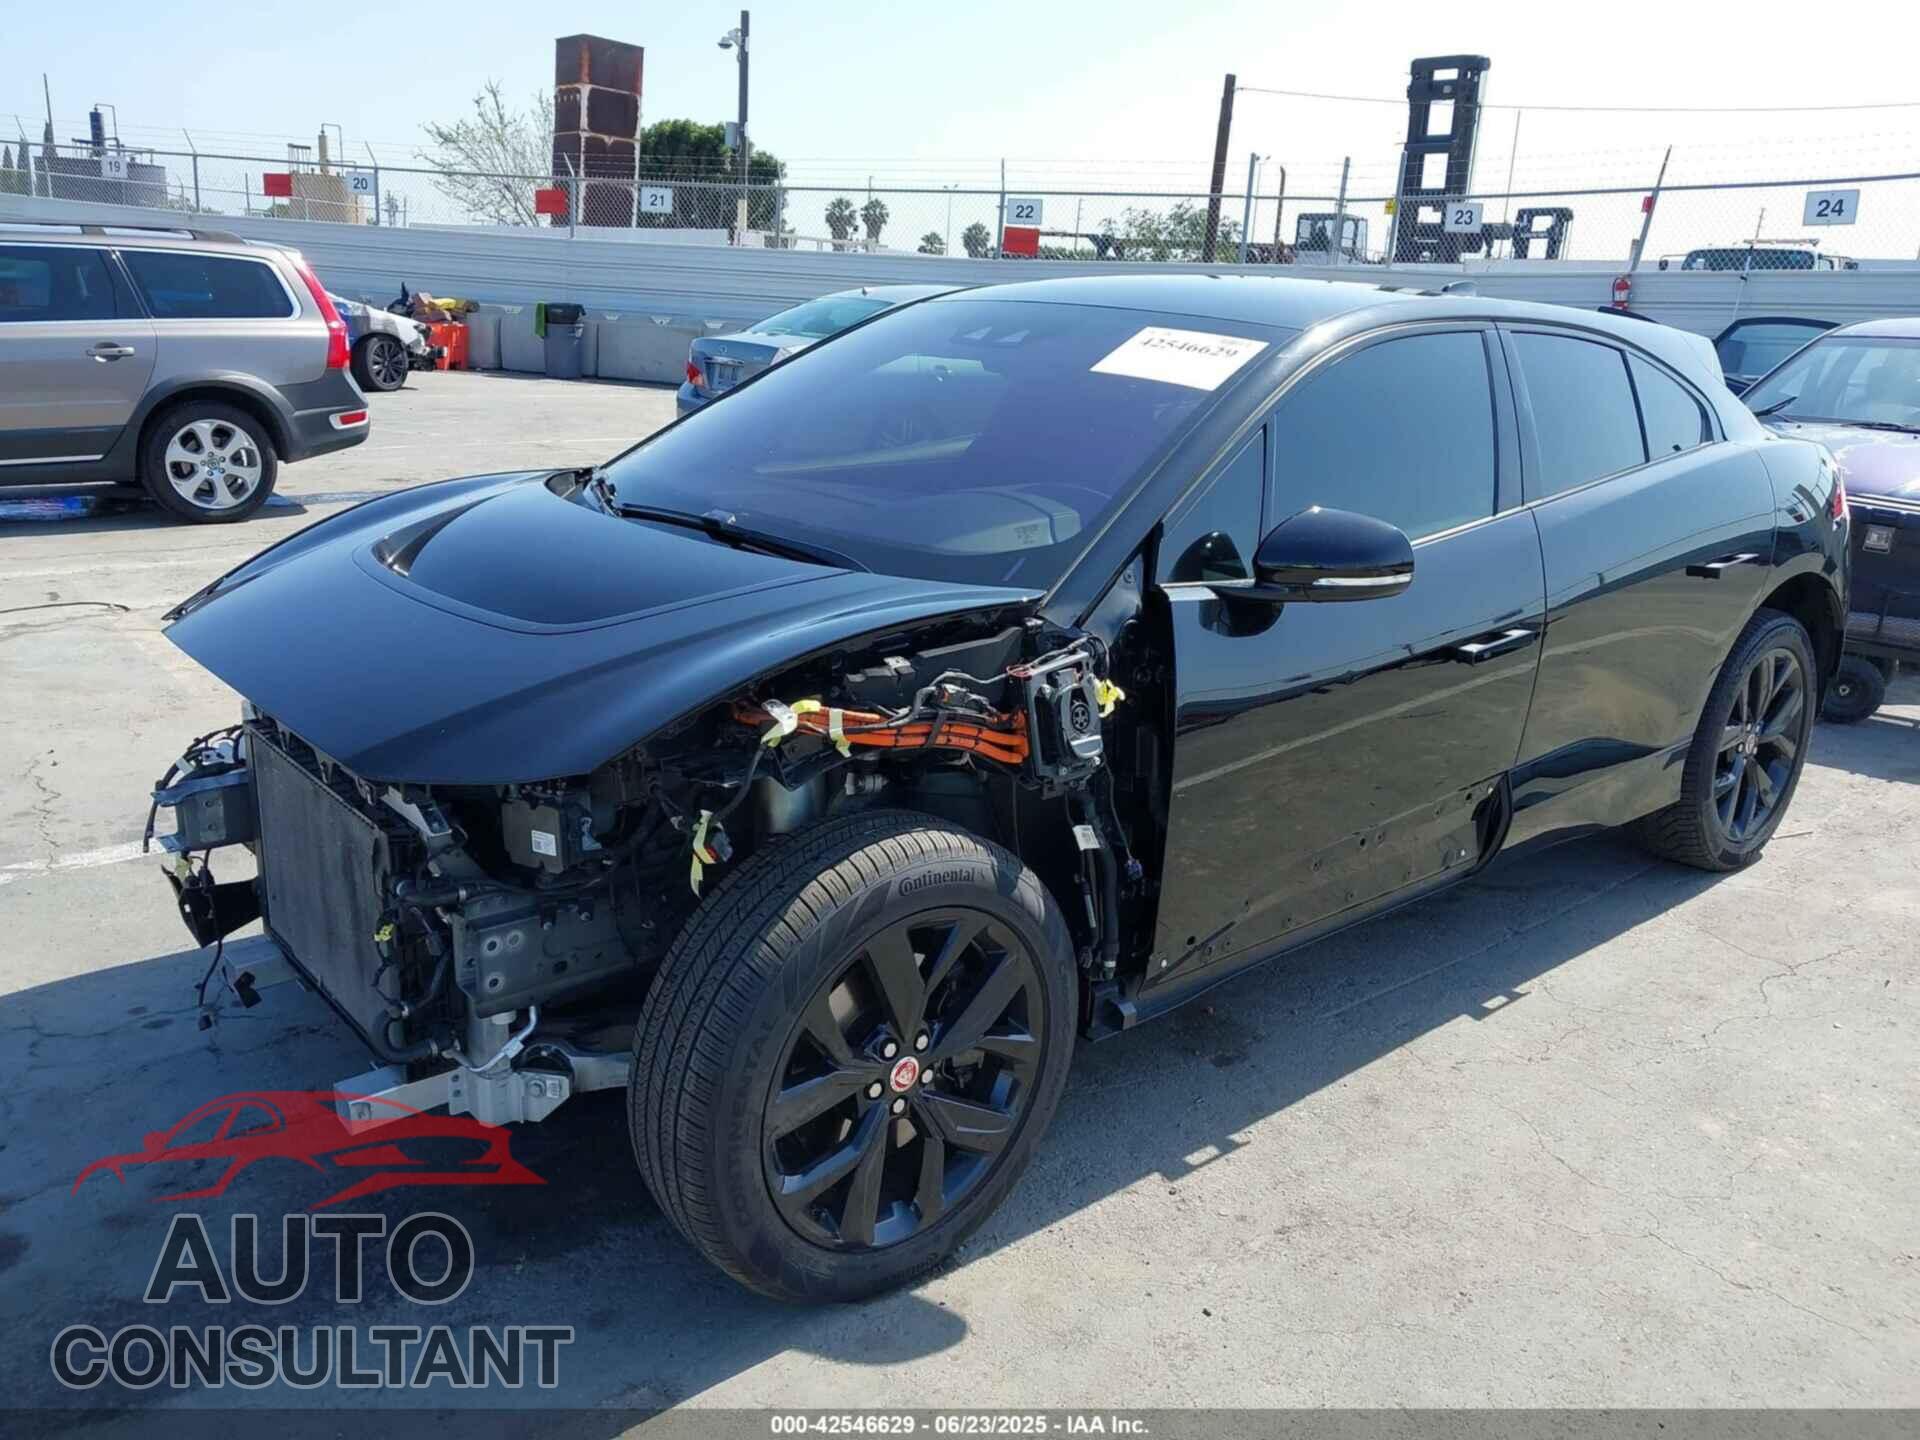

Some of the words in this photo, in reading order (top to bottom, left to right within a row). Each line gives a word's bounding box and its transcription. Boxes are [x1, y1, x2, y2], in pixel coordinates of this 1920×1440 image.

[109, 160, 121, 172] 19
[352, 176, 369, 190] 20
[650, 193, 665, 207] 21
[1015, 204, 1034, 218] 22
[1816, 198, 1844, 217] 24
[1454, 209, 1473, 225] 23
[899, 867, 976, 896] Continental
